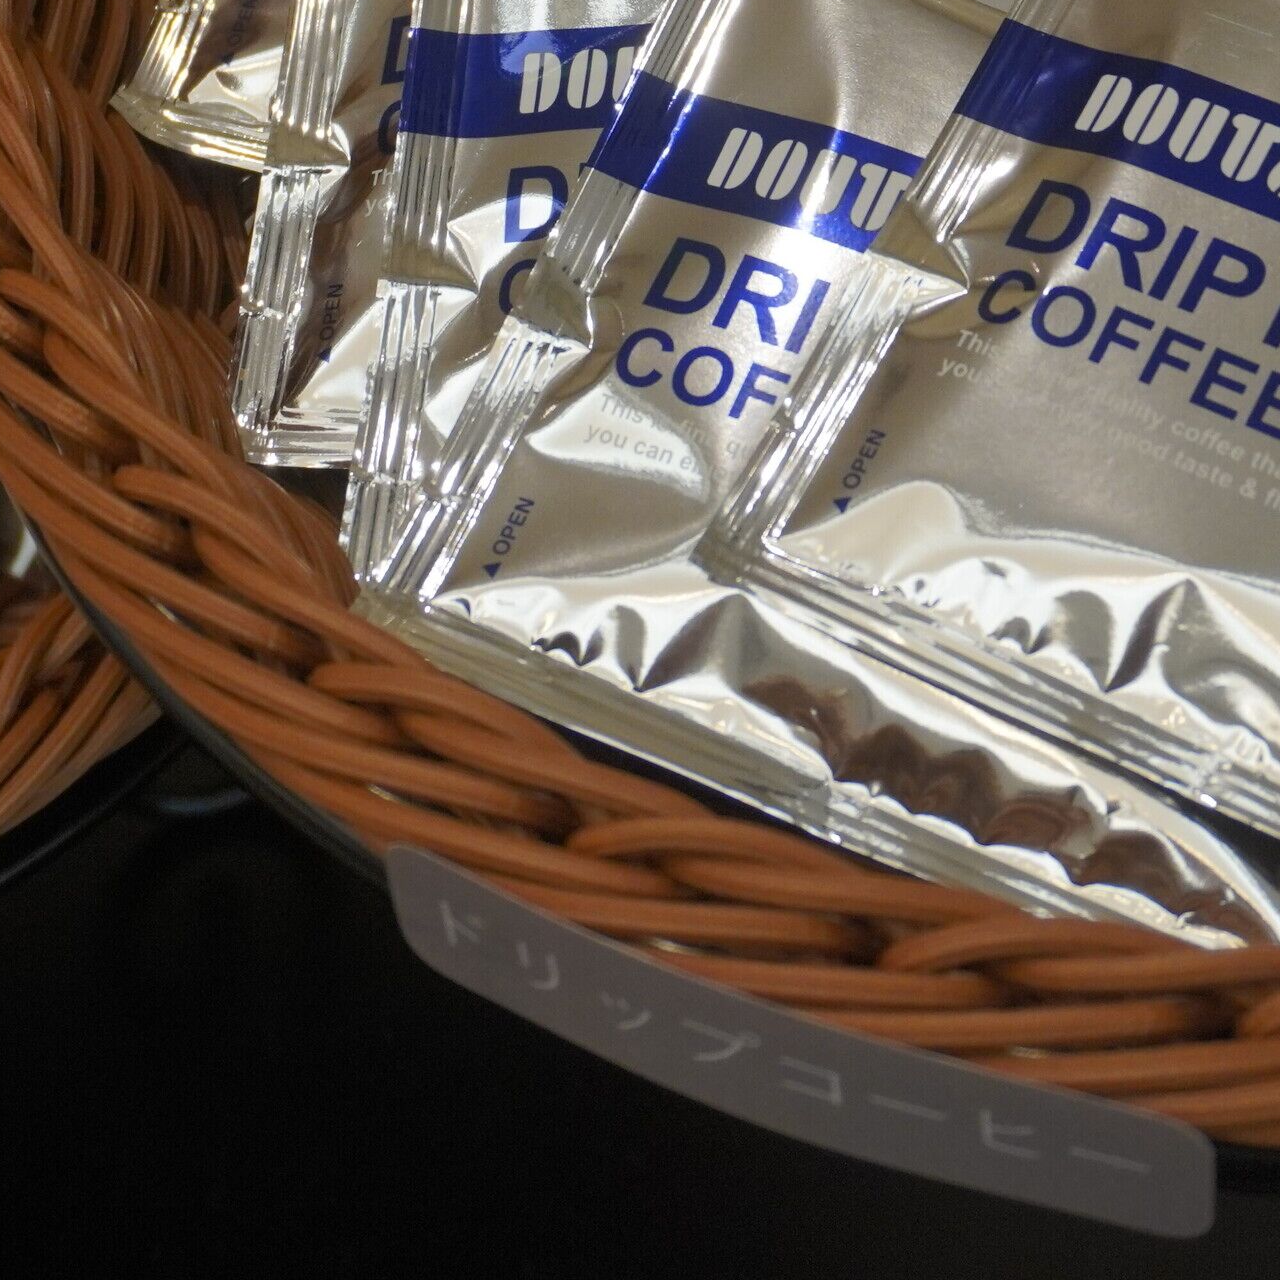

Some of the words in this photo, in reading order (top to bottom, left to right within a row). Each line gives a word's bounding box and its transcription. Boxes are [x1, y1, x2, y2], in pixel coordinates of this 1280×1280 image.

[707, 127, 913, 231] DOUT
[1005, 179, 1267, 314] DRIP
[320, 283, 344, 341] OPEN
[642, 236, 832, 355] DRI
[616, 327, 793, 420] COF
[600, 392, 643, 424] This
[583, 423, 629, 450] you
[633, 439, 674, 466] can
[843, 429, 886, 489] OPEN
[1170, 420, 1246, 462] coffee
[1174, 450, 1234, 488] taste
[1239, 477, 1257, 499] &
[492, 497, 535, 556] OPEN
